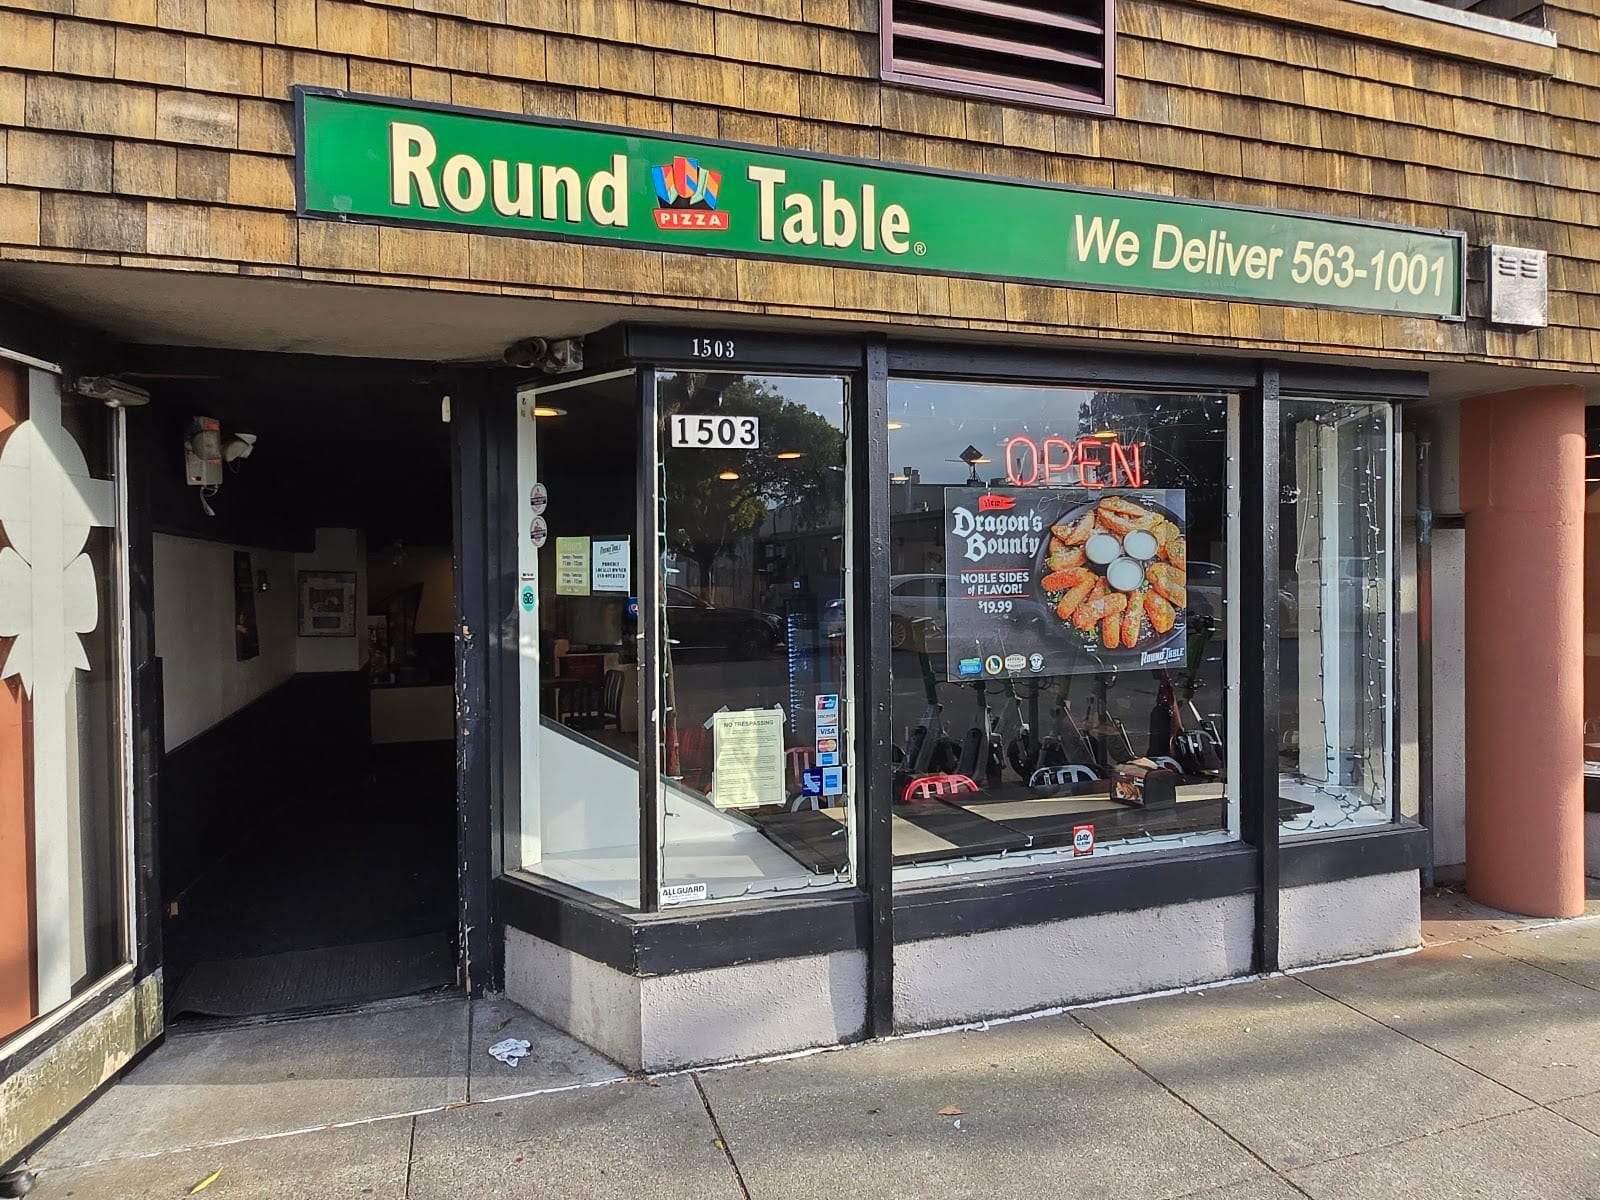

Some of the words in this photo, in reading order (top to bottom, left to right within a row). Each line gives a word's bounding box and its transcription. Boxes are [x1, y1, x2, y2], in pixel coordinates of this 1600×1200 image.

[389, 121, 629, 228] Round
[660, 212, 722, 227] PIZZA
[1074, 213, 1140, 267] We
[1152, 223, 1284, 281] Deliver
[1291, 240, 1445, 297] 563-1001
[692, 338, 735, 358] 1503
[677, 418, 756, 445] 1503
[1005, 435, 1142, 488] OPEN
[951, 506, 1043, 538] Dragon's
[964, 532, 1041, 562] Bounty
[961, 573, 997, 584] NOBLE
[999, 572, 1030, 583] SIDES
[967, 585, 976, 596] of
[977, 583, 1023, 595] FLAVOR!
[978, 600, 1013, 614] $19.99
[734, 719, 774, 727] TRESPASSING
[662, 885, 705, 896] ALLGUARD
